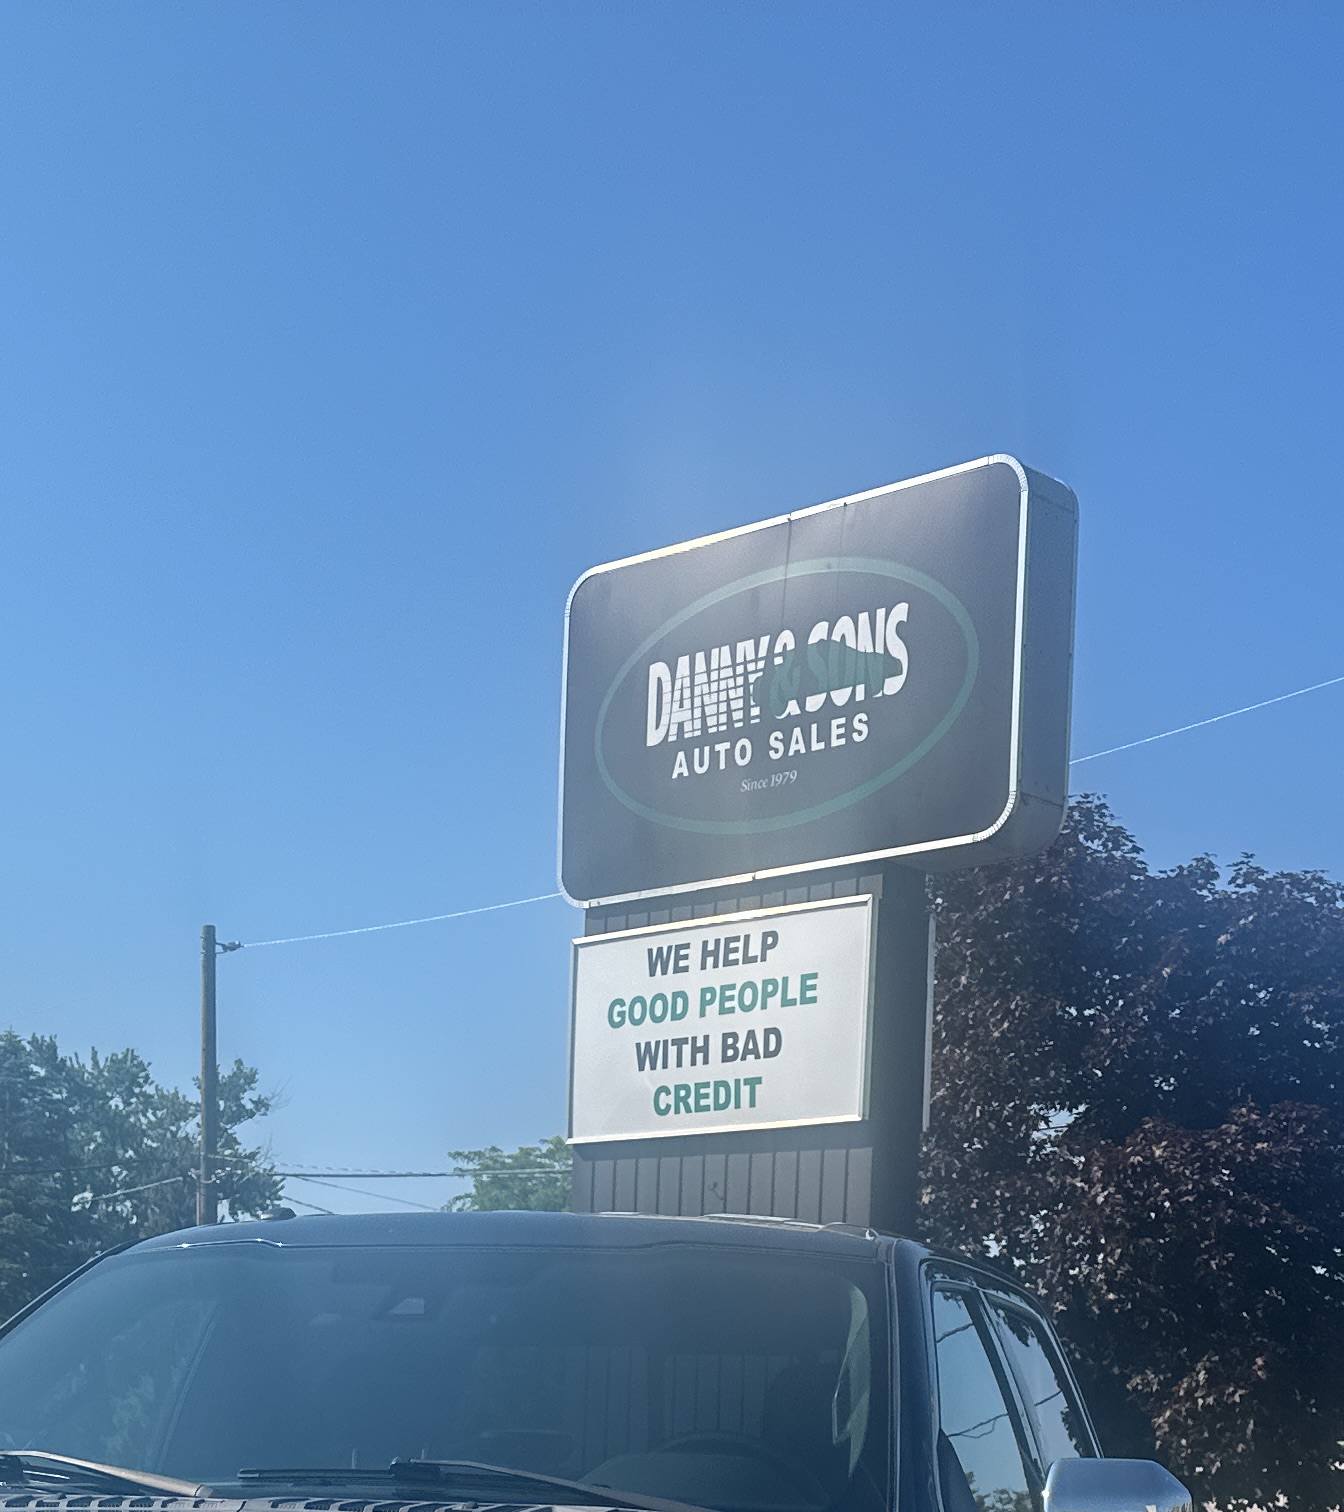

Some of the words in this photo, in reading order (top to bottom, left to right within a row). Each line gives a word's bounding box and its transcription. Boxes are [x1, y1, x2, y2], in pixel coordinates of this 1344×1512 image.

[646, 636, 769, 747] DANNY
[803, 602, 910, 711] SONS
[671, 738, 754, 780] AUTO
[768, 712, 871, 760] SALES
[740, 775, 769, 793] Since
[769, 769, 798, 789] 1979
[647, 942, 691, 978] WE
[700, 930, 779, 971] HELP
[607, 990, 689, 1029] GOOD
[699, 972, 819, 1018] PEOPLE
[635, 1034, 710, 1073] WITH
[720, 1027, 783, 1064] BAD
[652, 1076, 763, 1117] CREDIT
